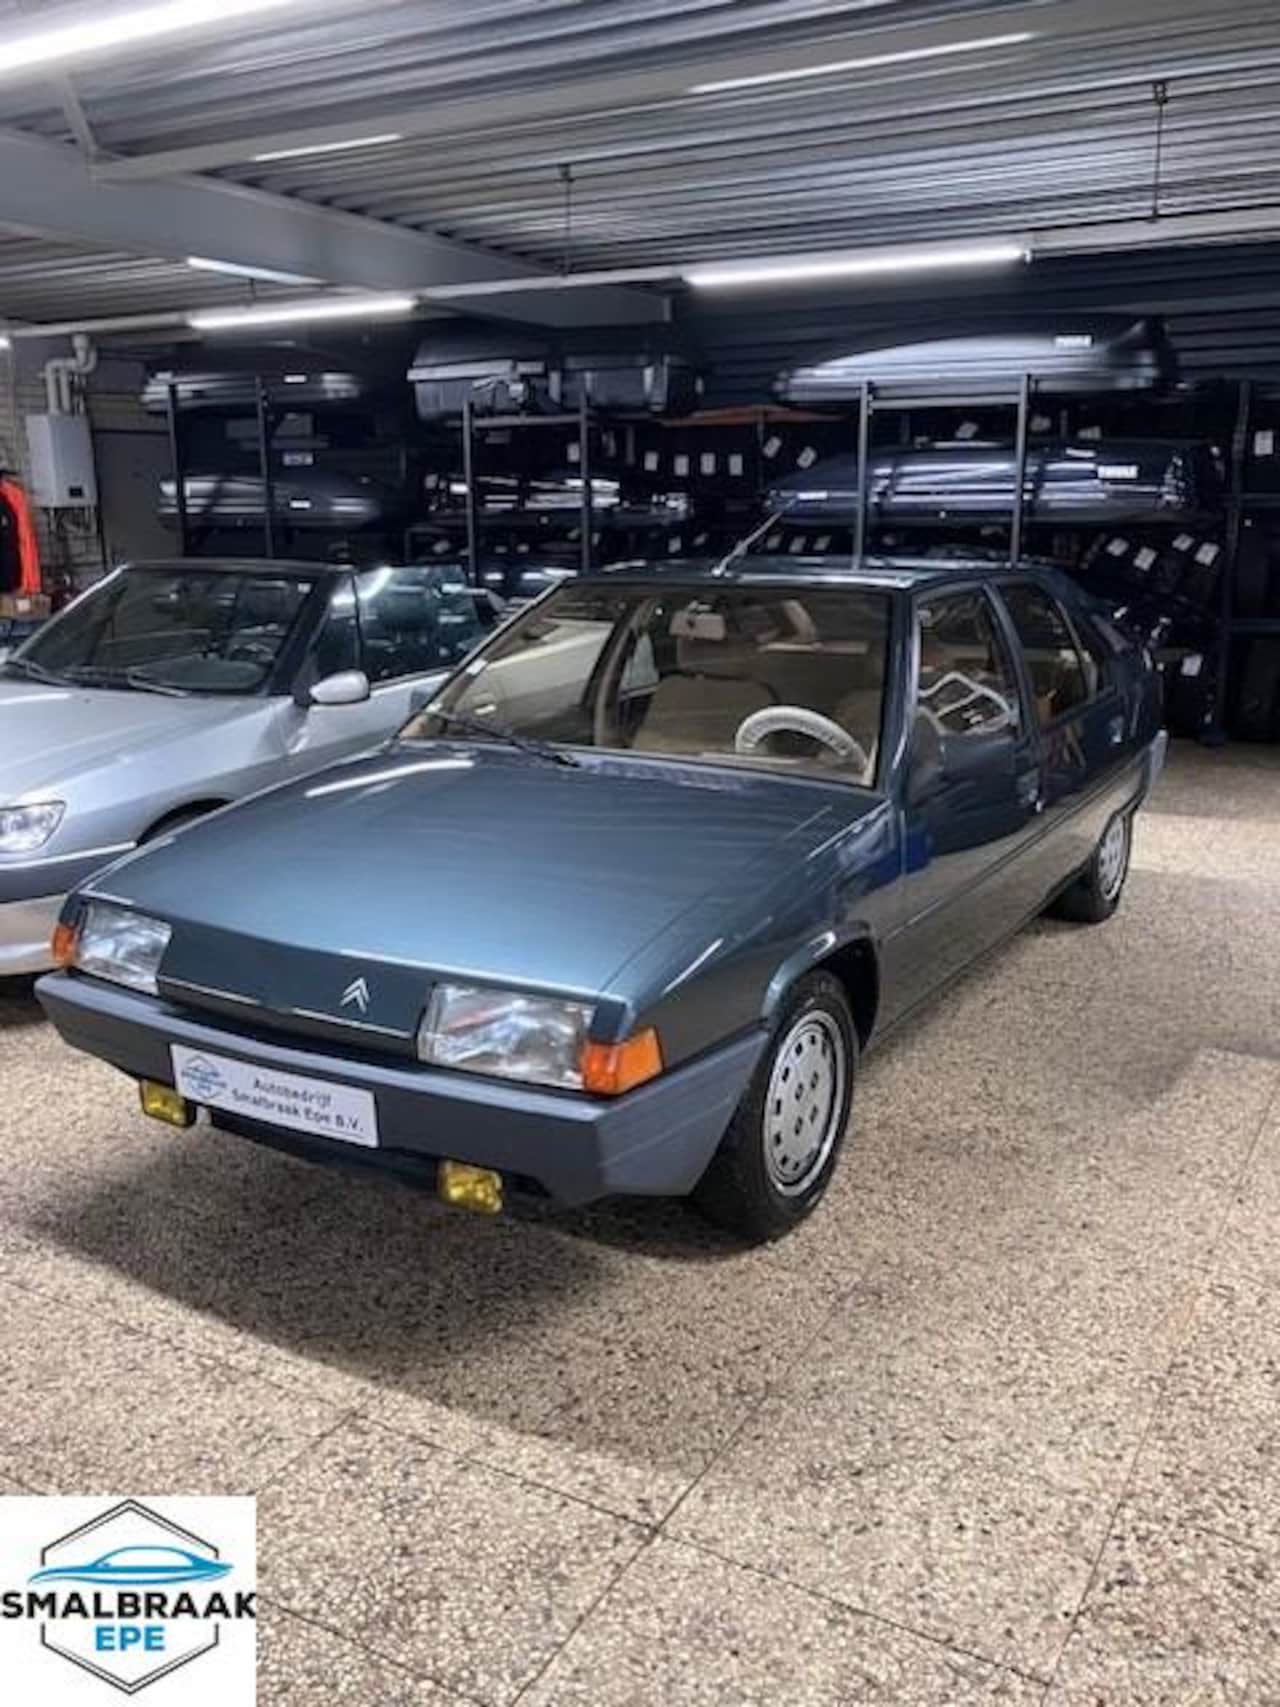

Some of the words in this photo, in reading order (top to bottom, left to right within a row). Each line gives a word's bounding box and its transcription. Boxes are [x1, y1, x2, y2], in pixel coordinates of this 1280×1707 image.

[232, 1088, 300, 1117] Smalbraak
[304, 1107, 331, 1123] Epe
[335, 1114, 364, 1132] B.V.
